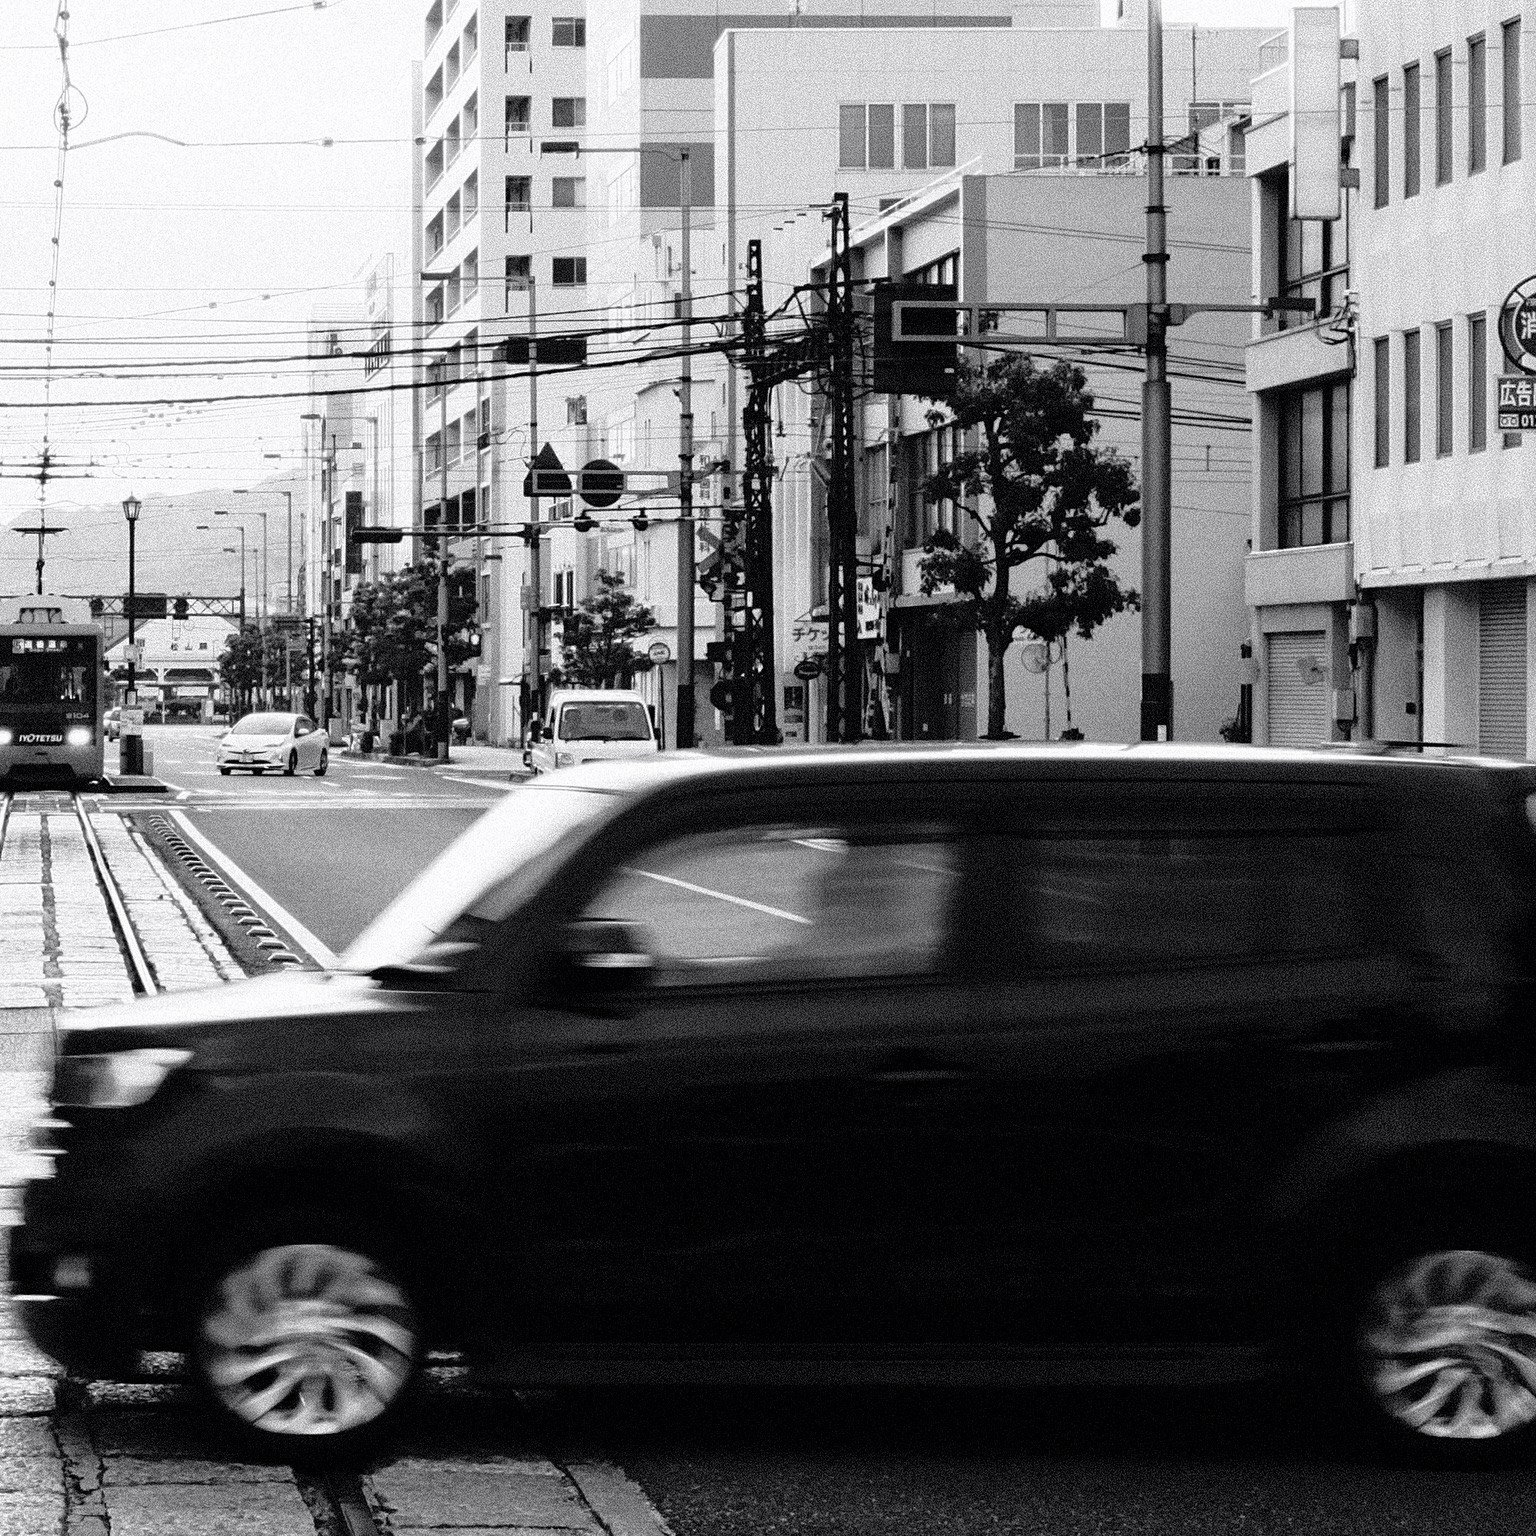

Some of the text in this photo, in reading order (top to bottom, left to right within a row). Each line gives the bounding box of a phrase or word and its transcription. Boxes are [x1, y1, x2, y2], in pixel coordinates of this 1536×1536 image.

[1500, 381, 1536, 406] 広告
[1521, 414, 1536, 427] 01
[19, 733, 63, 743] IYOTETSU
